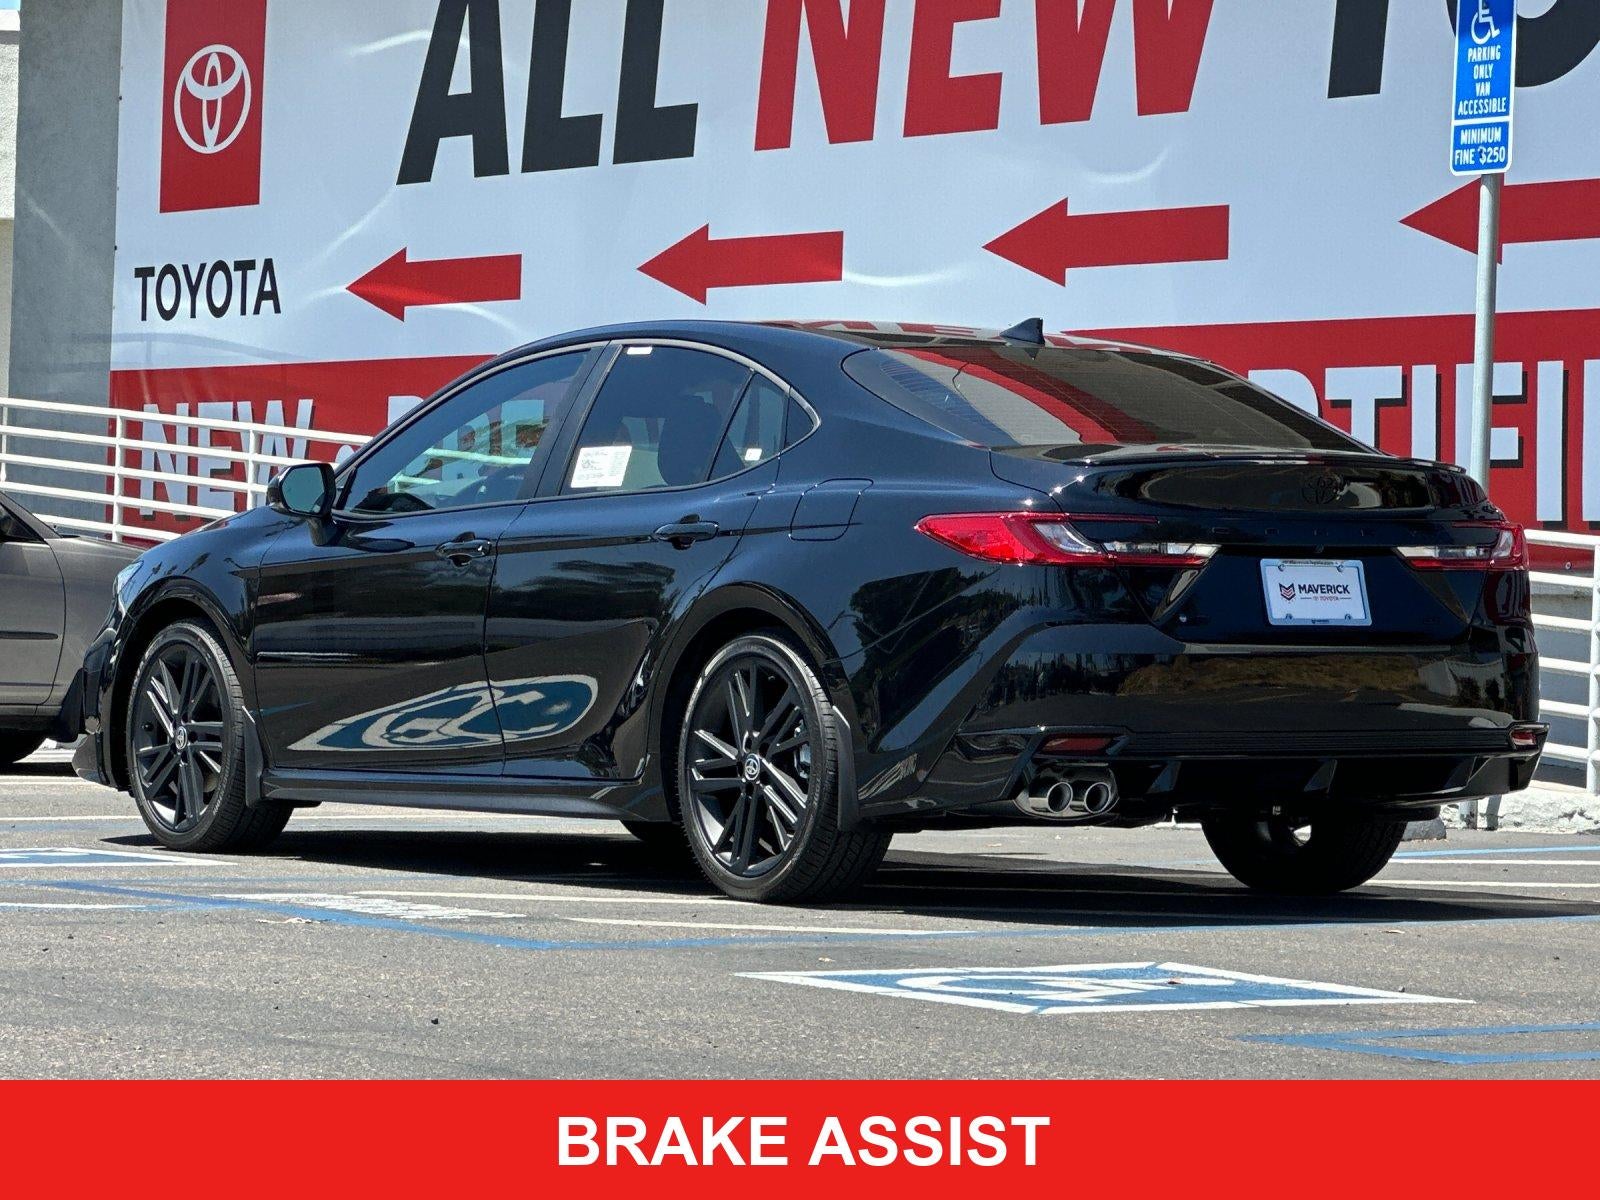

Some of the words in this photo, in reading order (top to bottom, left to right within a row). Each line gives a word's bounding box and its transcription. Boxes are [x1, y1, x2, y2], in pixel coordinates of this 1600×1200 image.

[1467, 45, 1501, 62] PARKING
[1473, 64, 1494, 80] ONLY
[396, 0, 697, 184] ALL
[1476, 81, 1490, 97] VAN
[1458, 97, 1507, 116] ACCESSIBLE
[1460, 127, 1502, 145] MINIMUM
[1455, 149, 1475, 166] FINE
[1479, 147, 1506, 165] $250
[134, 257, 281, 321] TOYOTA
[1248, 358, 1600, 522] TIFI
[1297, 583, 1351, 595] MAVERICK
